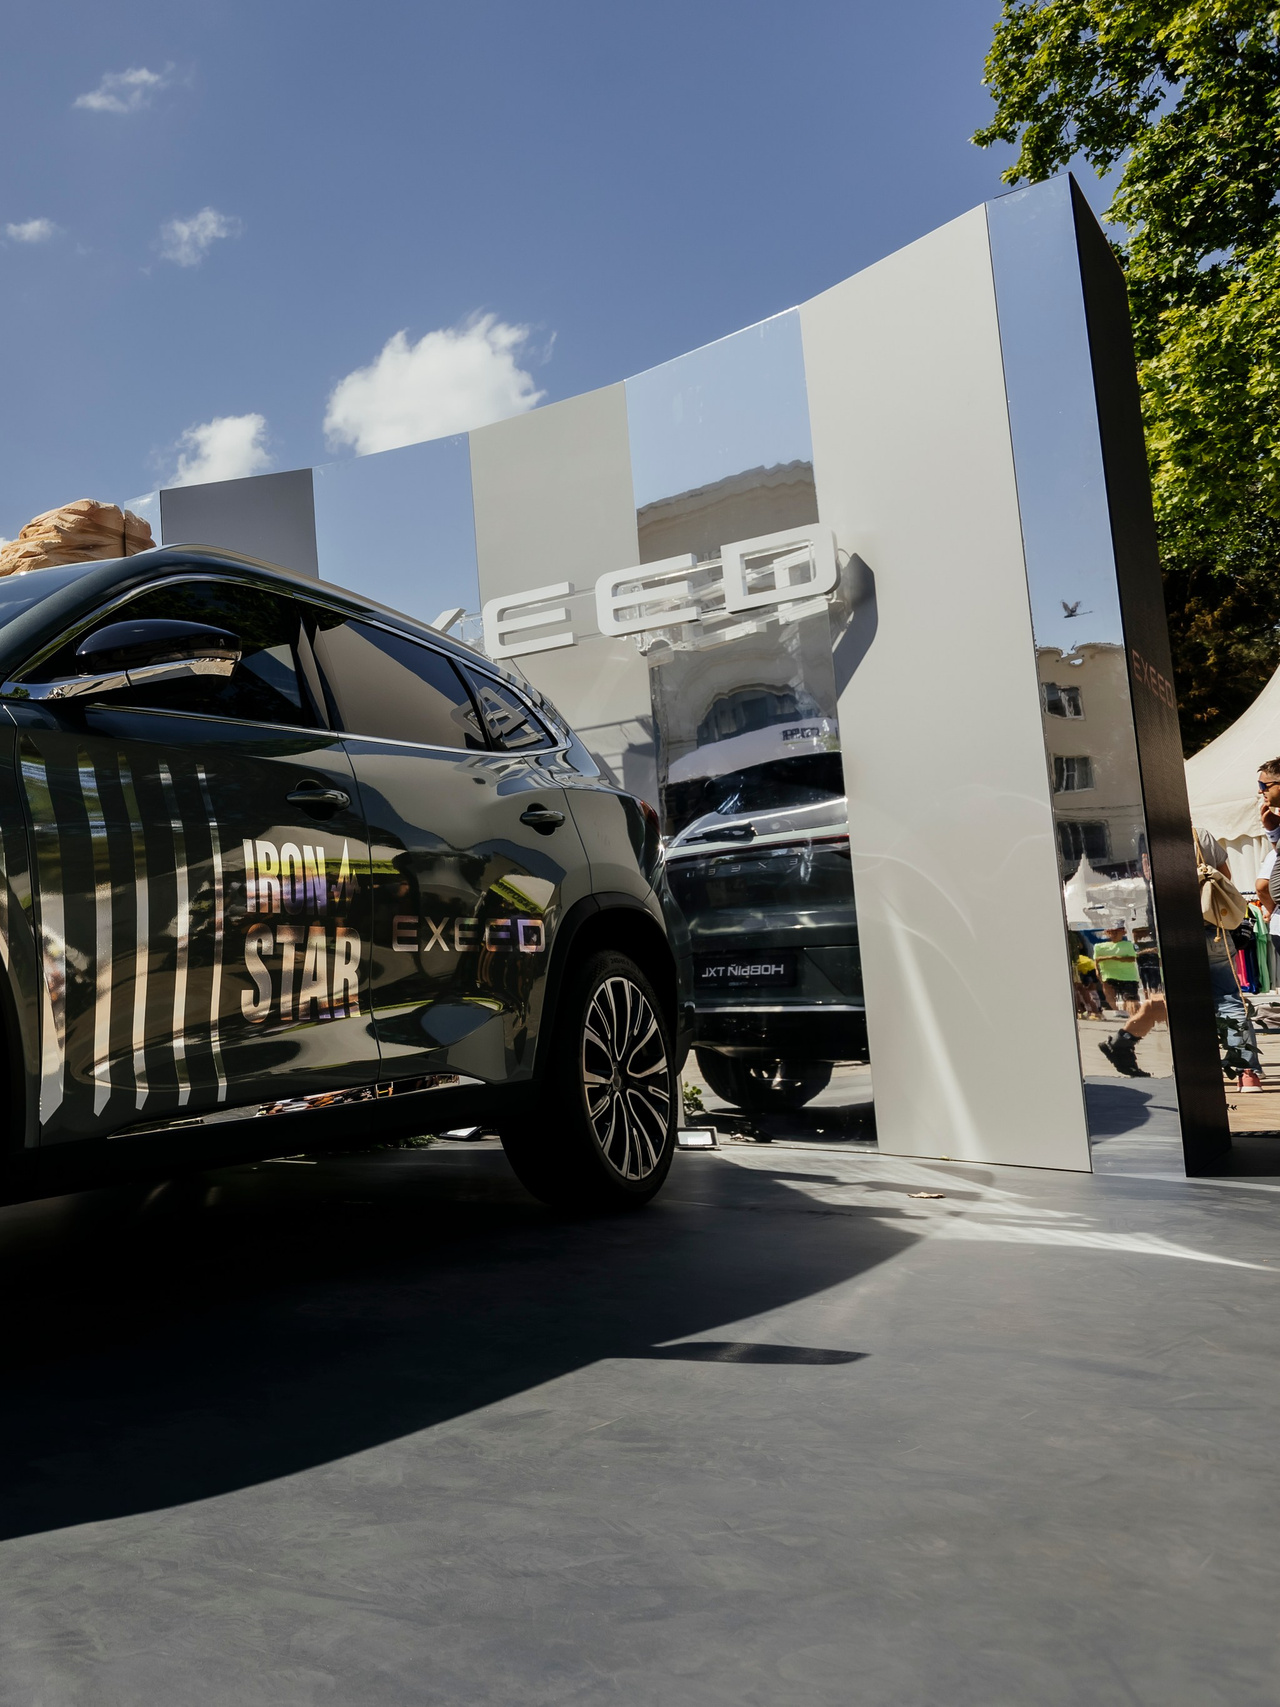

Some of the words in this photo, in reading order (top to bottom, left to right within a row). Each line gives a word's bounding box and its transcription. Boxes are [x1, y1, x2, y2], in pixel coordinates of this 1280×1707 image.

[431, 522, 839, 660] EED
[1132, 648, 1174, 708] EXEED
[242, 838, 328, 915] IRON
[241, 922, 362, 1023] STAR
[392, 915, 546, 953] EXEED
